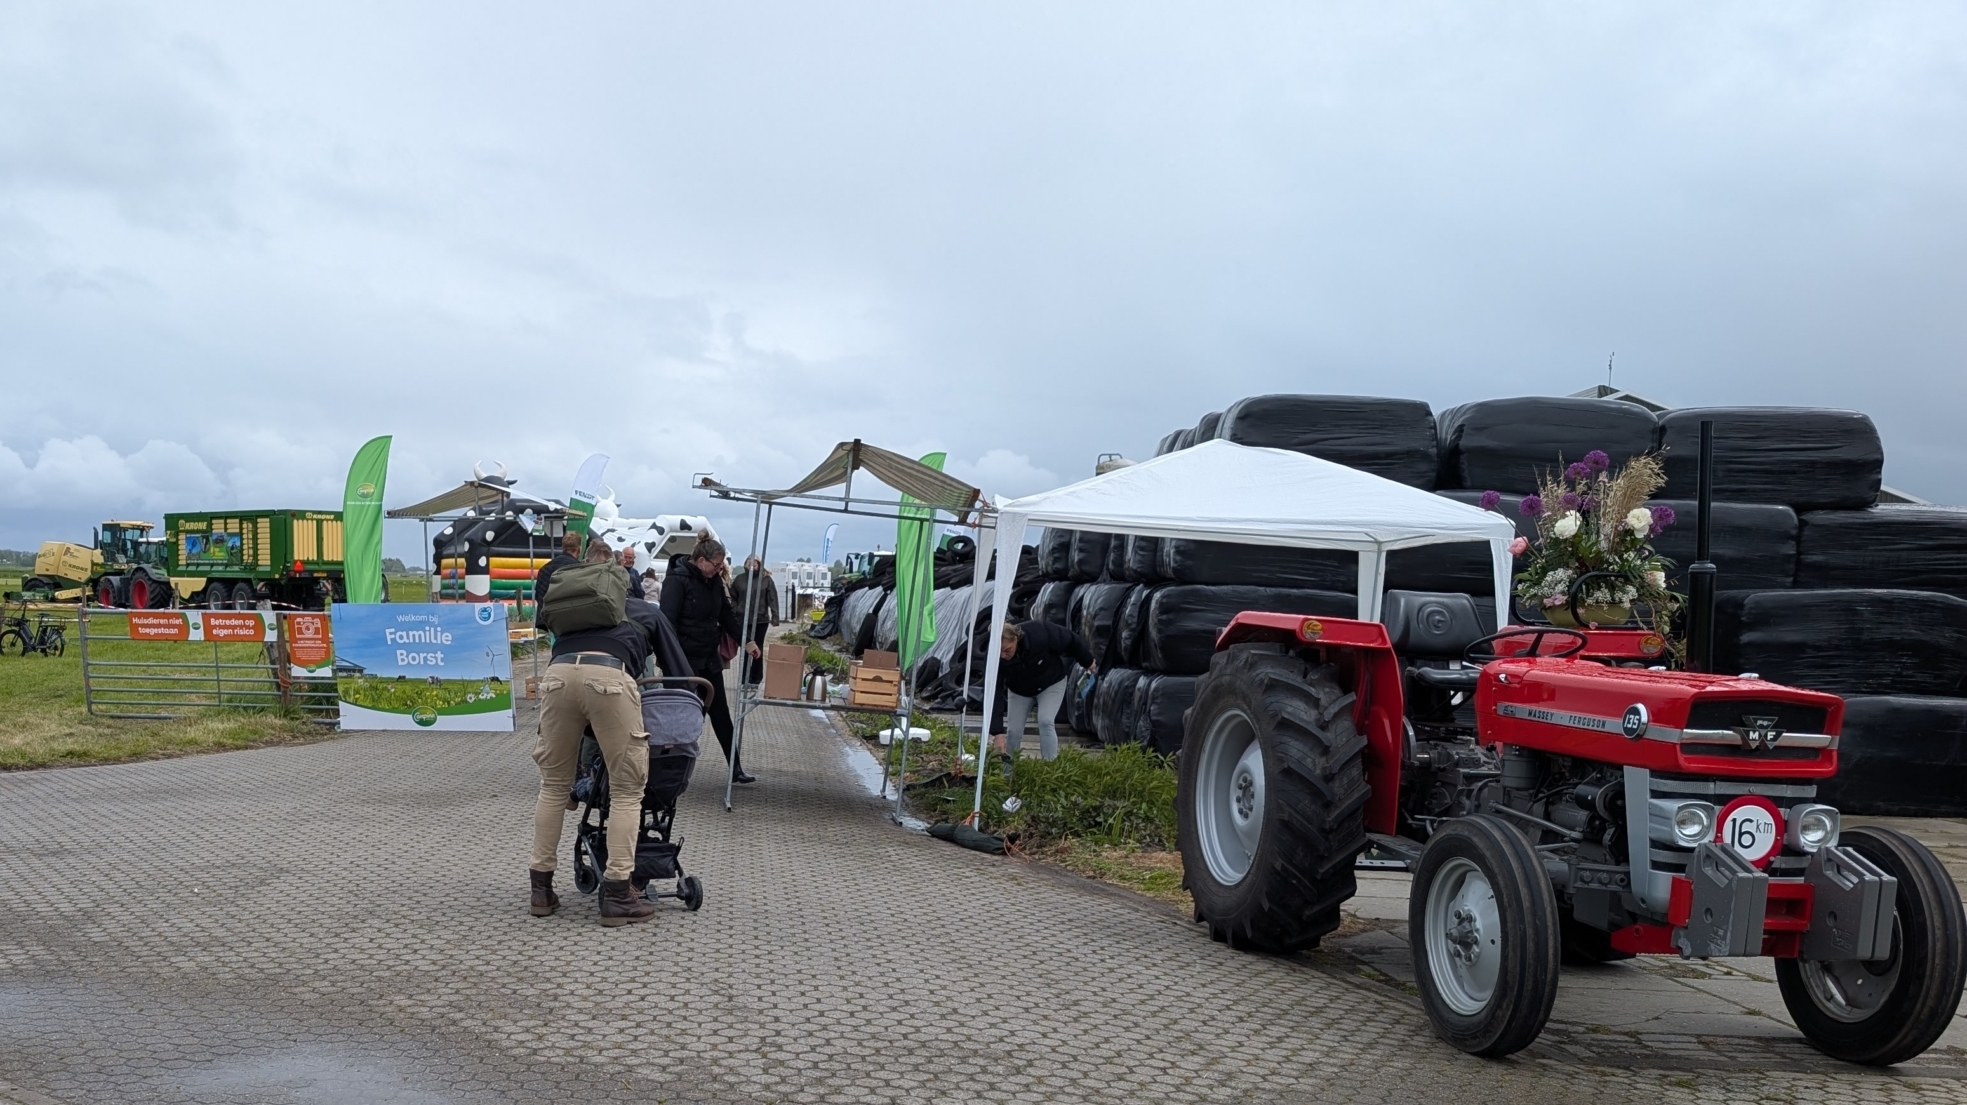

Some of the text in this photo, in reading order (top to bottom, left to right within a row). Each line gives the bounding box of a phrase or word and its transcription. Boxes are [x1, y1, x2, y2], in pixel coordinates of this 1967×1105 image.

[575, 490, 595, 500] FENDT
[185, 521, 208, 530] KRONE
[68, 564, 88, 572] KRONE
[132, 617, 168, 625] Huisdieren
[169, 617, 183, 626] niet
[210, 618, 243, 627] Betreden
[244, 619, 255, 629] op
[396, 614, 438, 624] Welkom bij
[138, 626, 179, 636] toegestaan
[212, 627, 255, 638] eigen risico
[385, 626, 453, 645] Familie
[396, 649, 445, 666] Borst
[1528, 708, 1555, 721] MASSEY
[1568, 714, 1607, 730] FERGUSON
[1623, 713, 1640, 729] 135
[1730, 817, 1773, 850] 16 km
